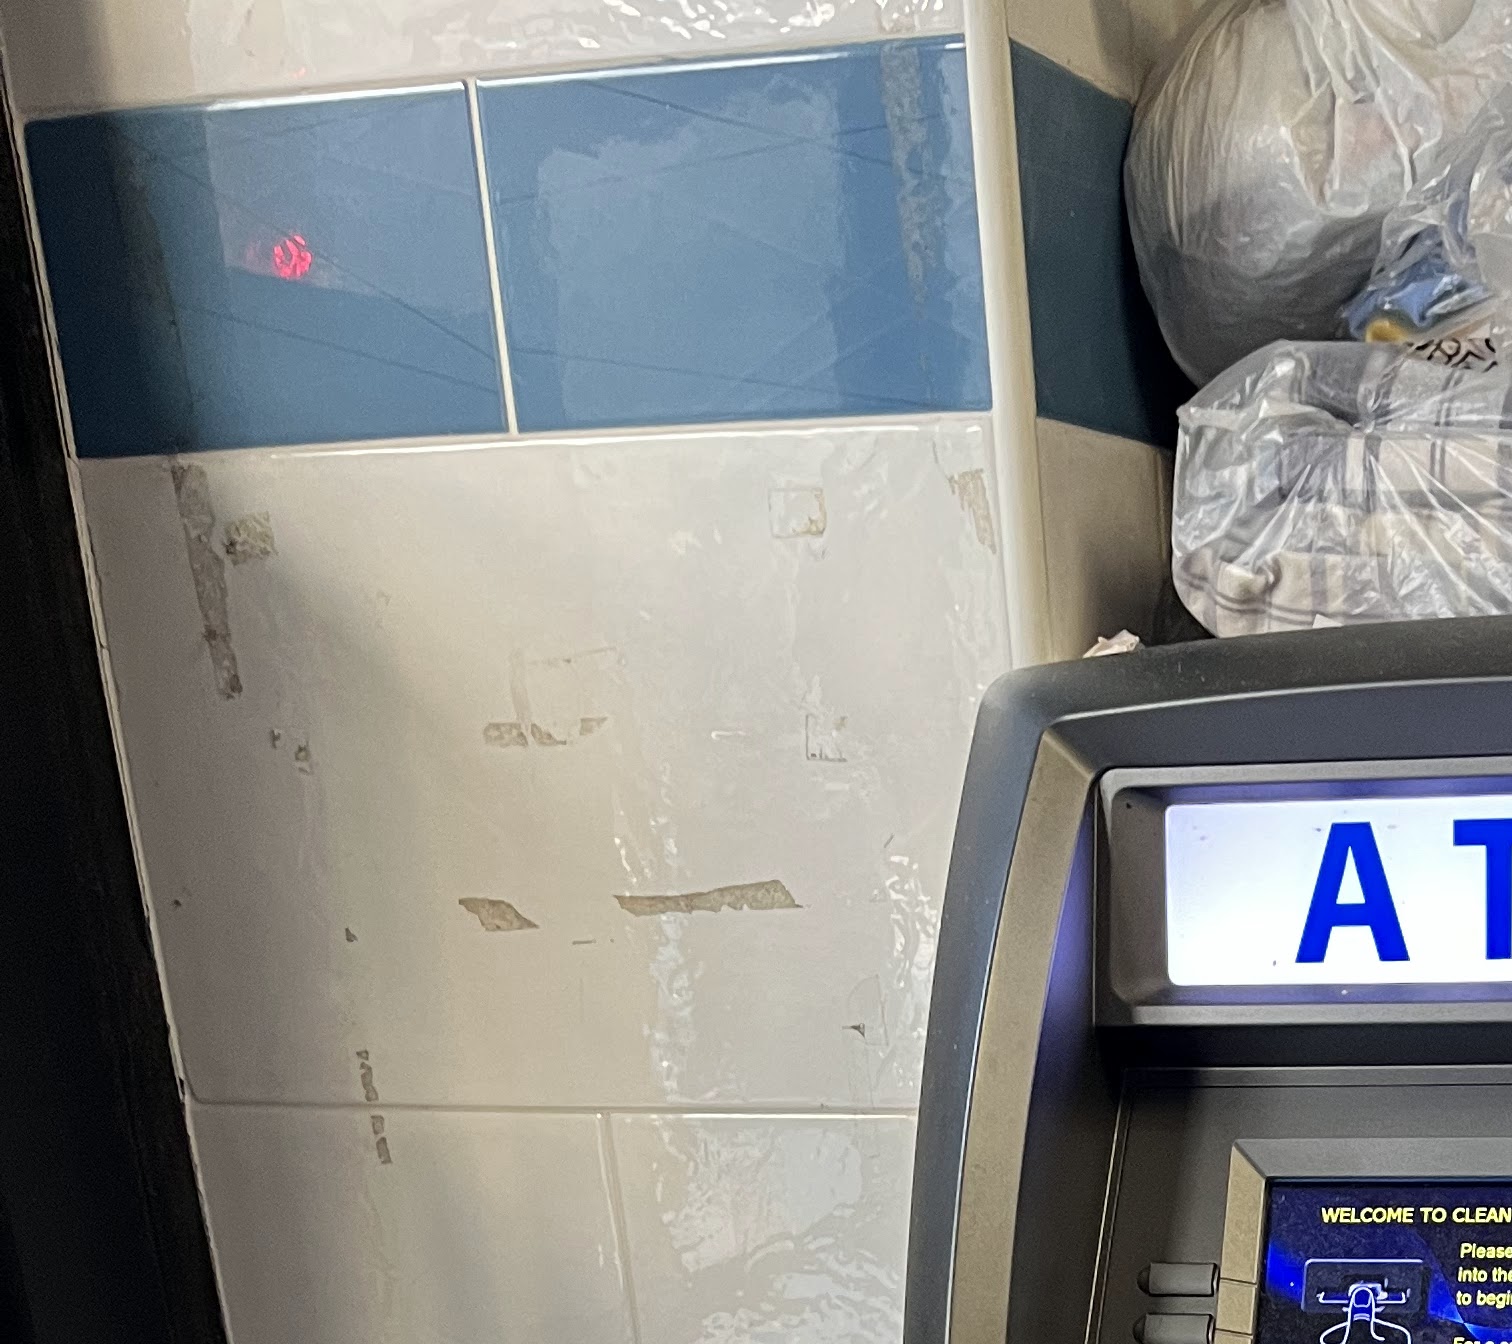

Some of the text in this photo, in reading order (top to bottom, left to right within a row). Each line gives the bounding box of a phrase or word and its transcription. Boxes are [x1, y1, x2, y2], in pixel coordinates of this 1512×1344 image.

[1321, 1207, 1415, 1224] WELCOME
[1420, 1207, 1448, 1223] TO
[1452, 1207, 1512, 1224] CLEAN
[1457, 1268, 1488, 1283] into
[1456, 1291, 1472, 1306] to
